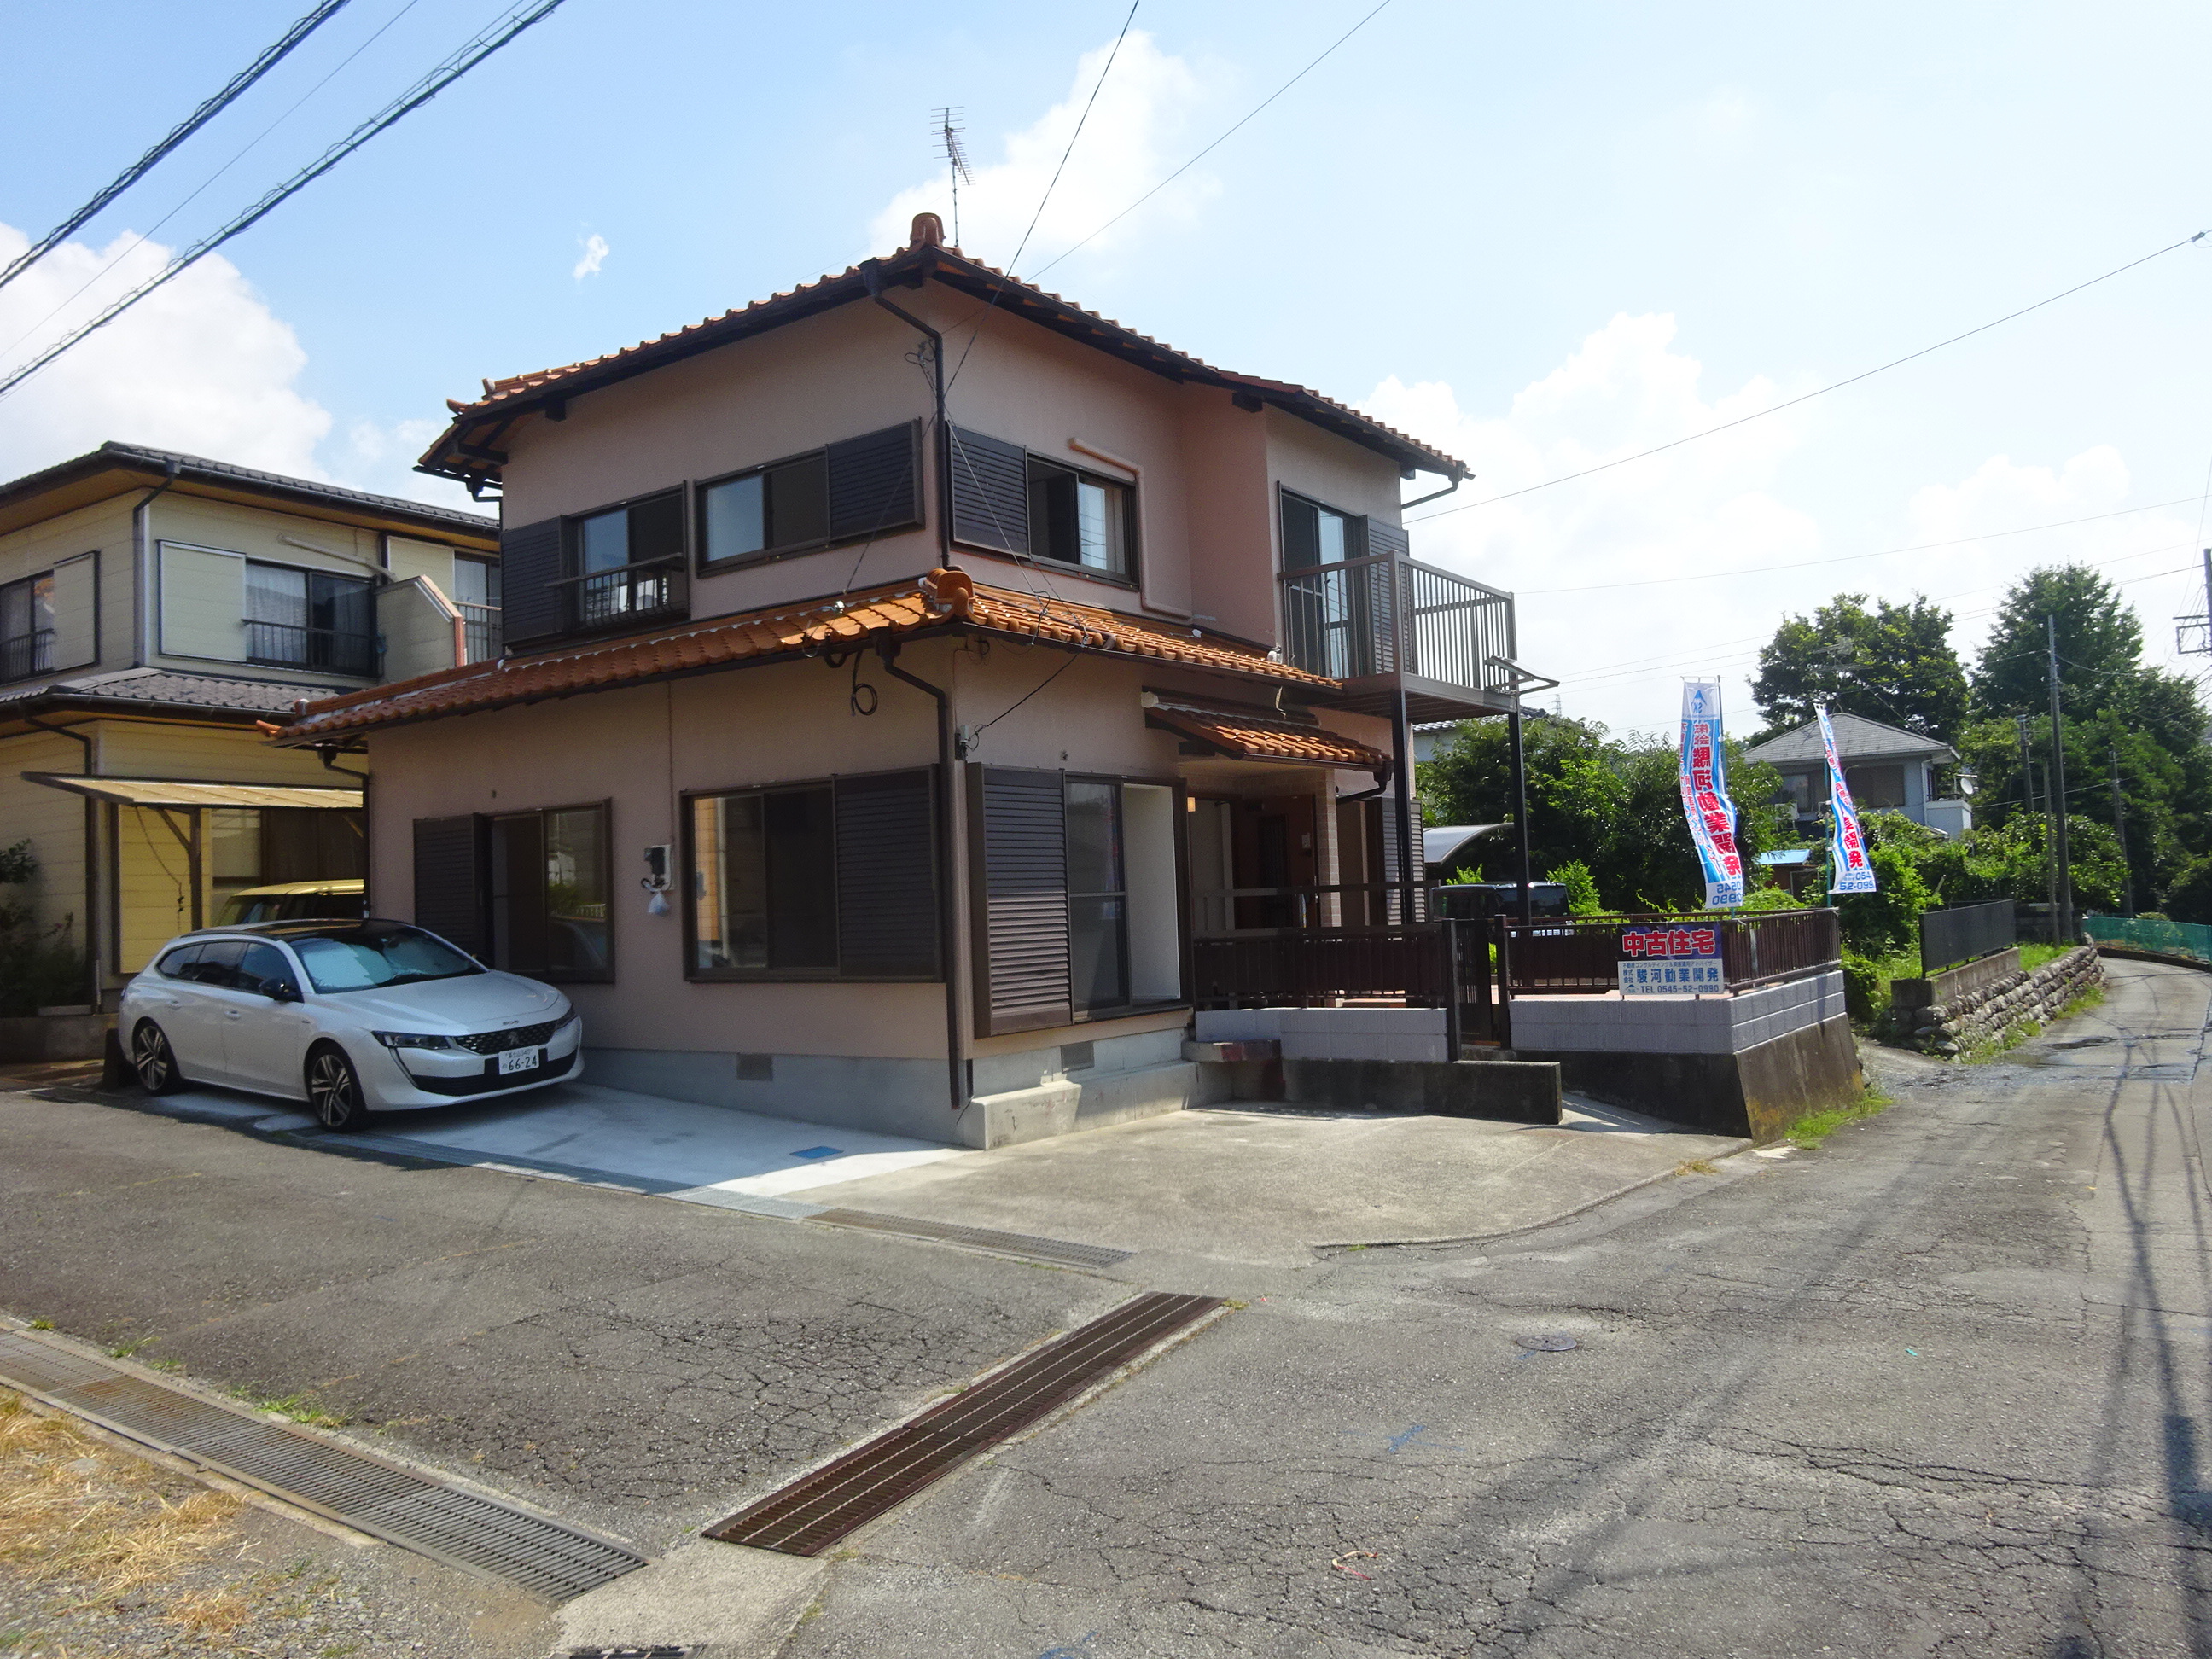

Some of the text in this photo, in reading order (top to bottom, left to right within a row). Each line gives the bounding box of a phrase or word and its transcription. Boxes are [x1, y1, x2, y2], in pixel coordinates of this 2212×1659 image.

[1622, 928, 1715, 957] 中古住宅
[1637, 968, 1719, 984] 駿河勧業開発
[1657, 984, 1719, 993] 0545-52-0990
[509, 1055, 537, 1070] 66-24
